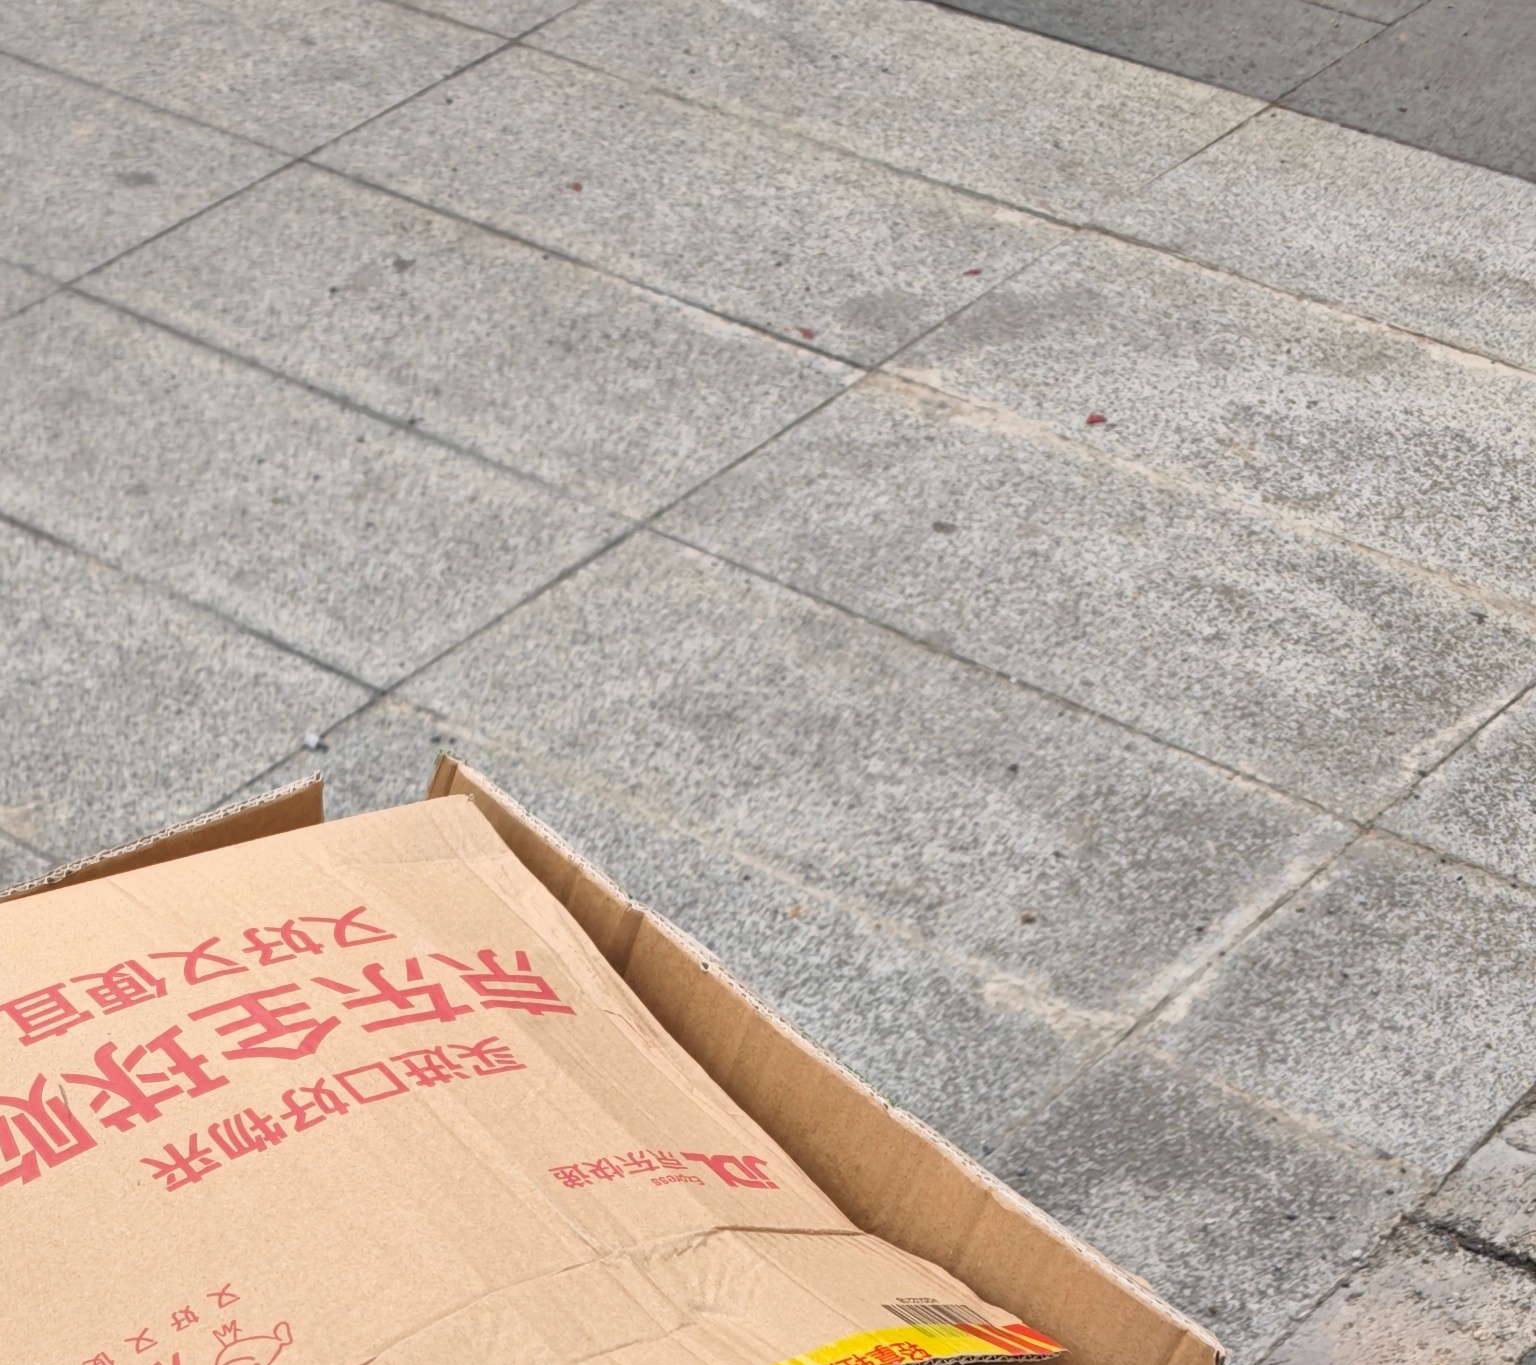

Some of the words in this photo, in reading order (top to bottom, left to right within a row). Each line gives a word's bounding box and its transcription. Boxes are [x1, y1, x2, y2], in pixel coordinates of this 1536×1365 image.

[548, 1149, 689, 1190] 京东快递
[650, 1173, 705, 1188] Express
